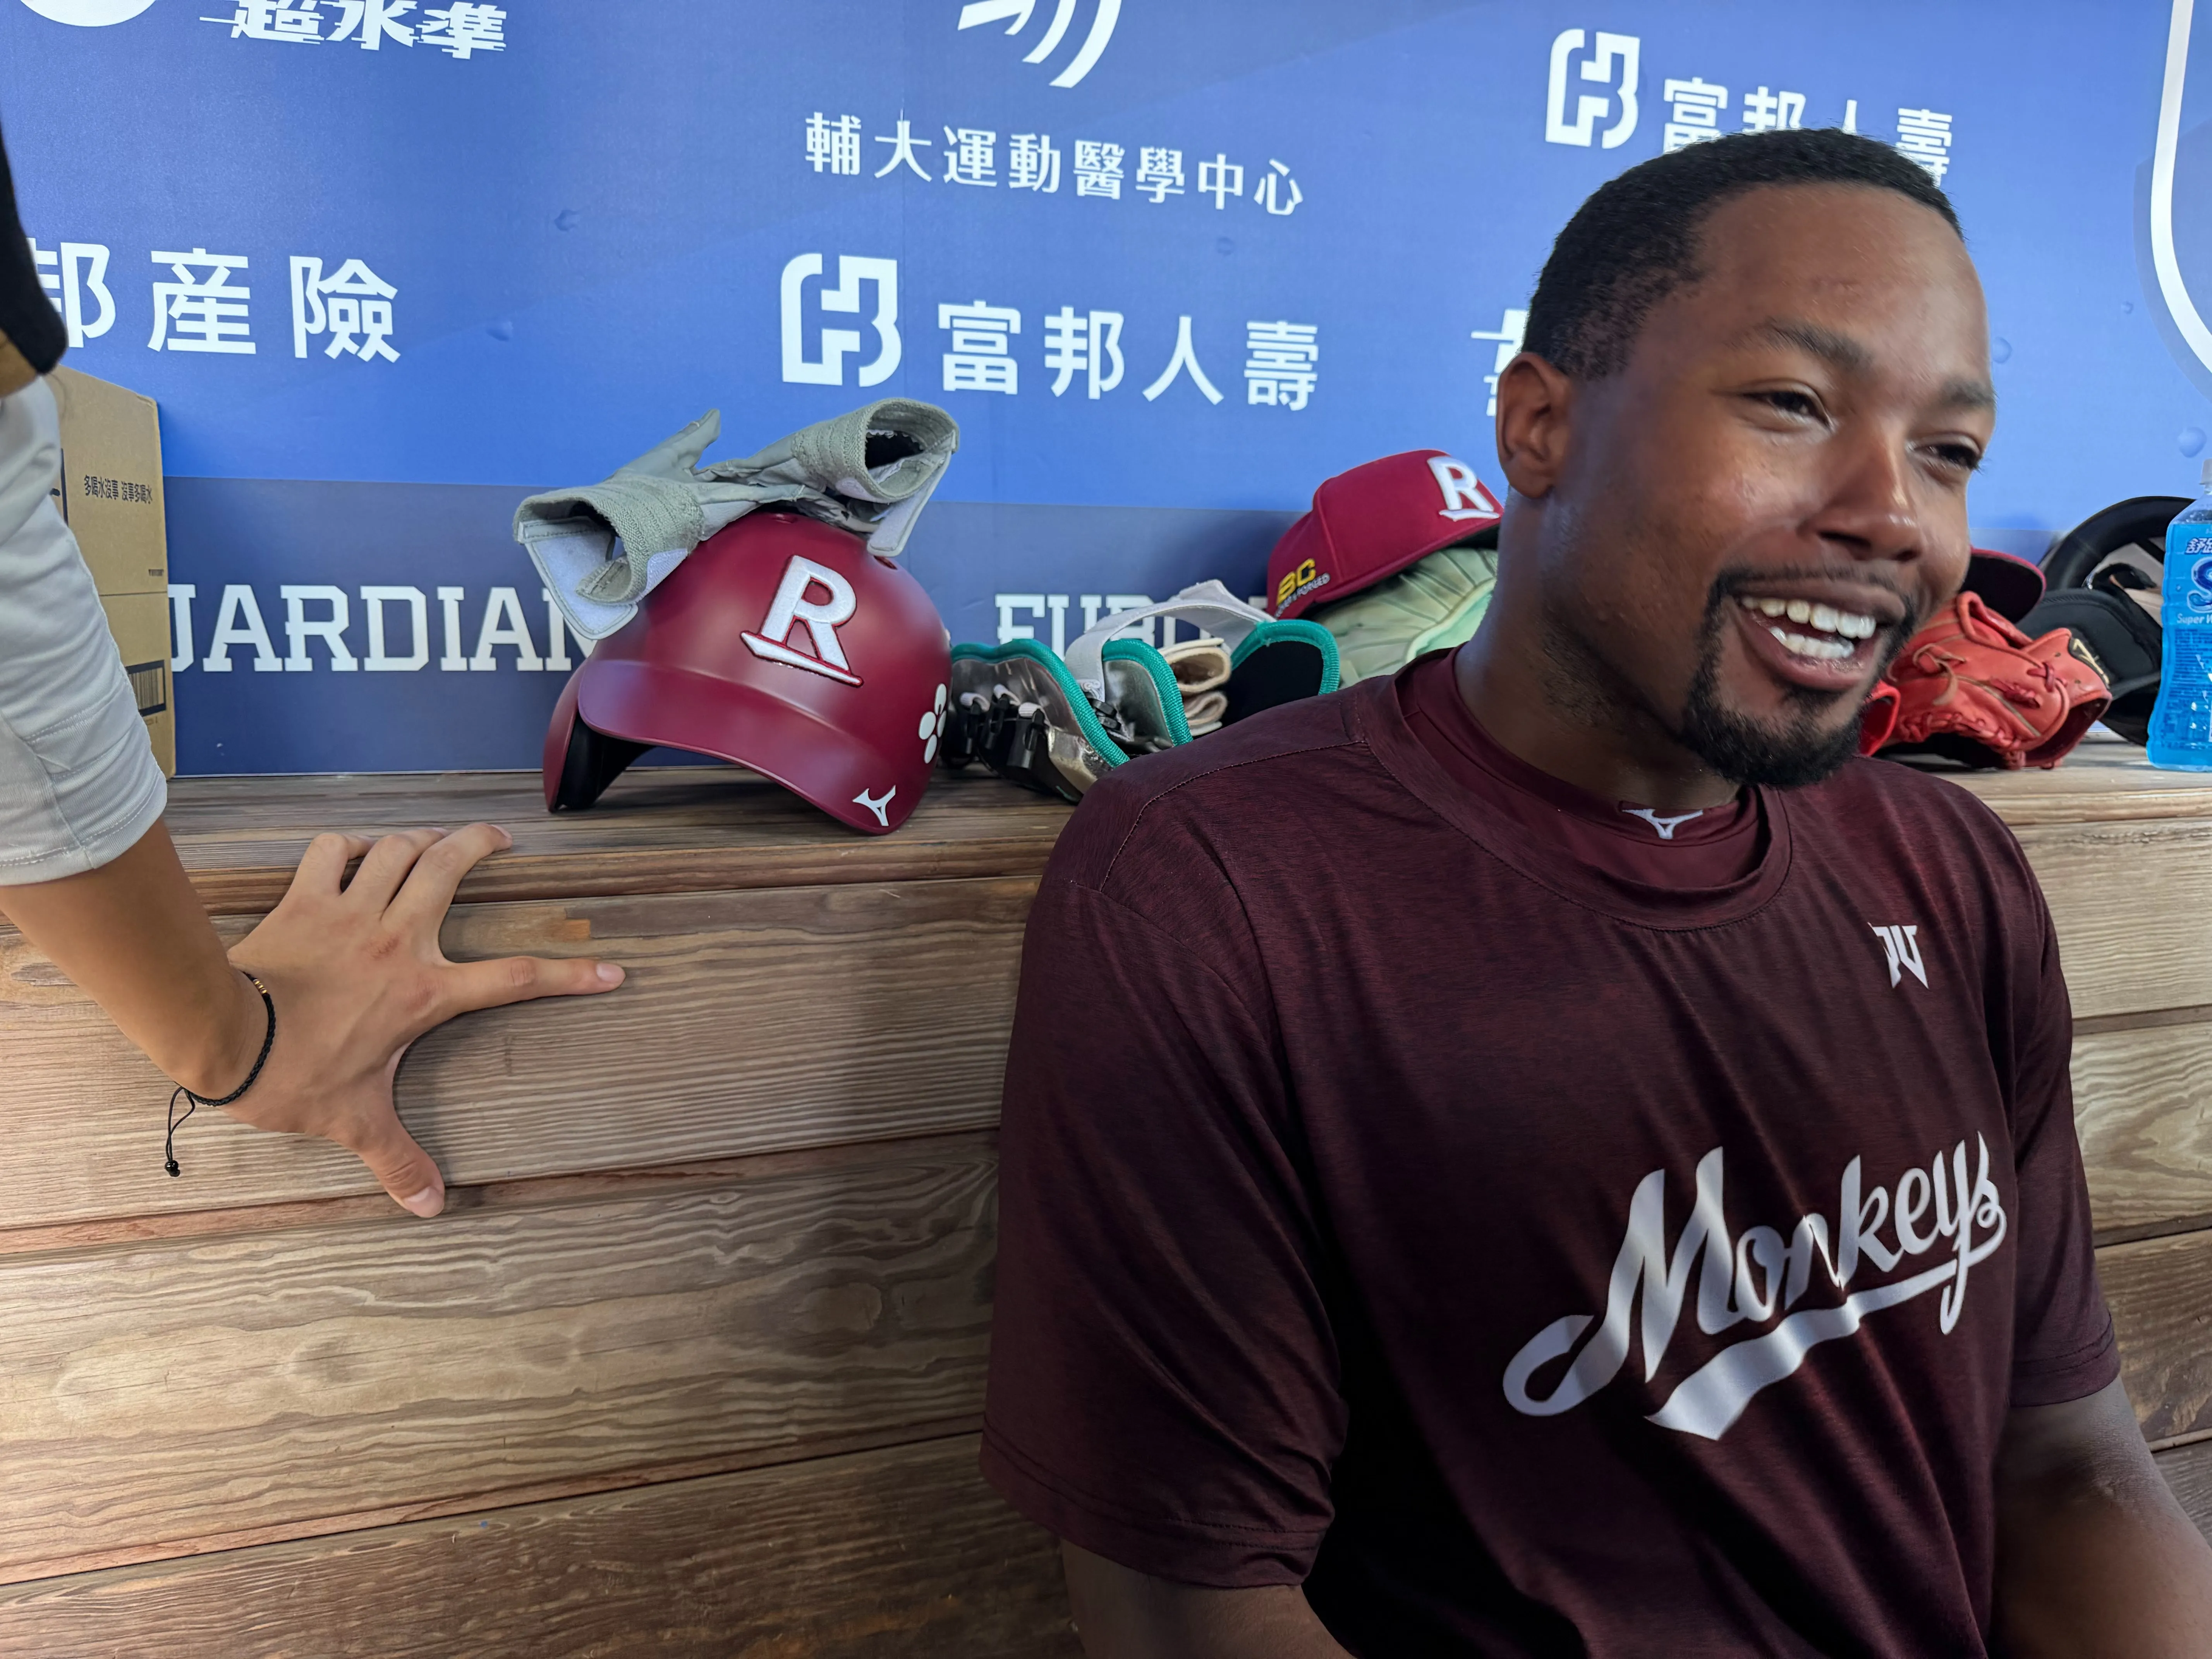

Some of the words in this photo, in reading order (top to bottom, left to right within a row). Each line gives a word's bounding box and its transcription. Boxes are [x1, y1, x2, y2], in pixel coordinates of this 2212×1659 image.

[805, 111, 1304, 216] 輔大運動醫學中心
[938, 300, 1319, 411] 富邦人壽
[1427, 456, 1499, 521] R
[741, 555, 863, 686] R
[1503, 1131, 2008, 1418] Monkeys
